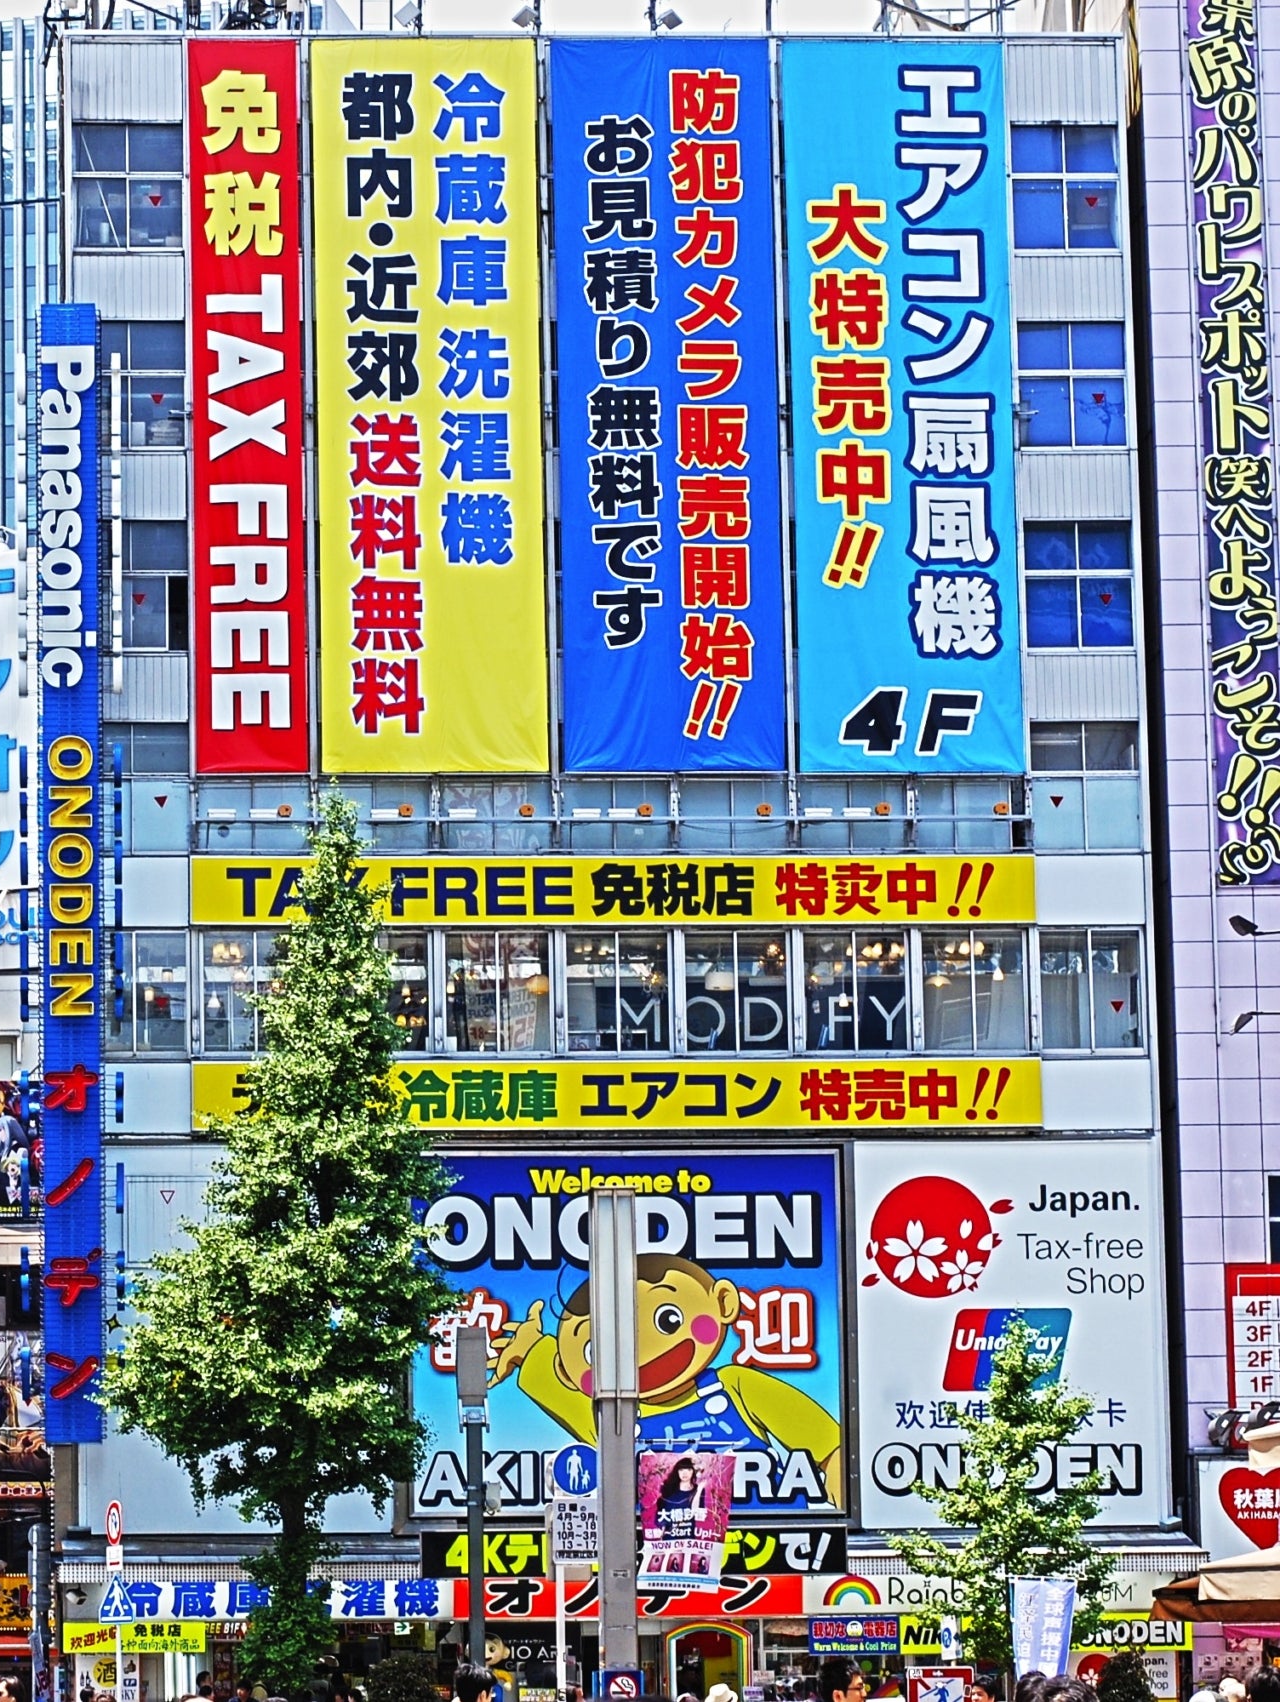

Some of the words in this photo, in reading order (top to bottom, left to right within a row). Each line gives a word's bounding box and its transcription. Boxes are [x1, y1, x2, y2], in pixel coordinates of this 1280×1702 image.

[201, 69, 284, 258] 免税
[206, 273, 287, 460] TAX
[584, 114, 664, 650] お見積り無料です
[896, 65, 998, 660] エアコン扇風機
[808, 186, 892, 590] 大特売中!!
[41, 345, 97, 689] Panasonic
[209, 482, 291, 731] FREE
[838, 686, 984, 758] 4F
[47, 735, 94, 1017] ONODEN
[391, 866, 574, 916] FREE
[592, 863, 756, 917] 免税店
[614, 996, 910, 1044] MODFY
[397, 1069, 558, 1122] 冷蔵庫
[580, 1072, 782, 1118] エアコン
[531, 1168, 672, 1194] Welcome
[677, 1169, 712, 1193] to
[1029, 1184, 1140, 1218] Japan.
[45, 1063, 98, 1400] オノデン
[1017, 1233, 1143, 1260] Tax-free
[1066, 1267, 1145, 1299] Shop
[1245, 1301, 1270, 1317] 4F
[1246, 1325, 1271, 1342] 3F
[1247, 1350, 1272, 1367] 2F
[1250, 1376, 1272, 1392] 1F
[895, 1398, 1127, 1429] 欢迎使卡
[557, 1513, 597, 1521] 4月~9月
[134, 1624, 182, 1637] 免税店
